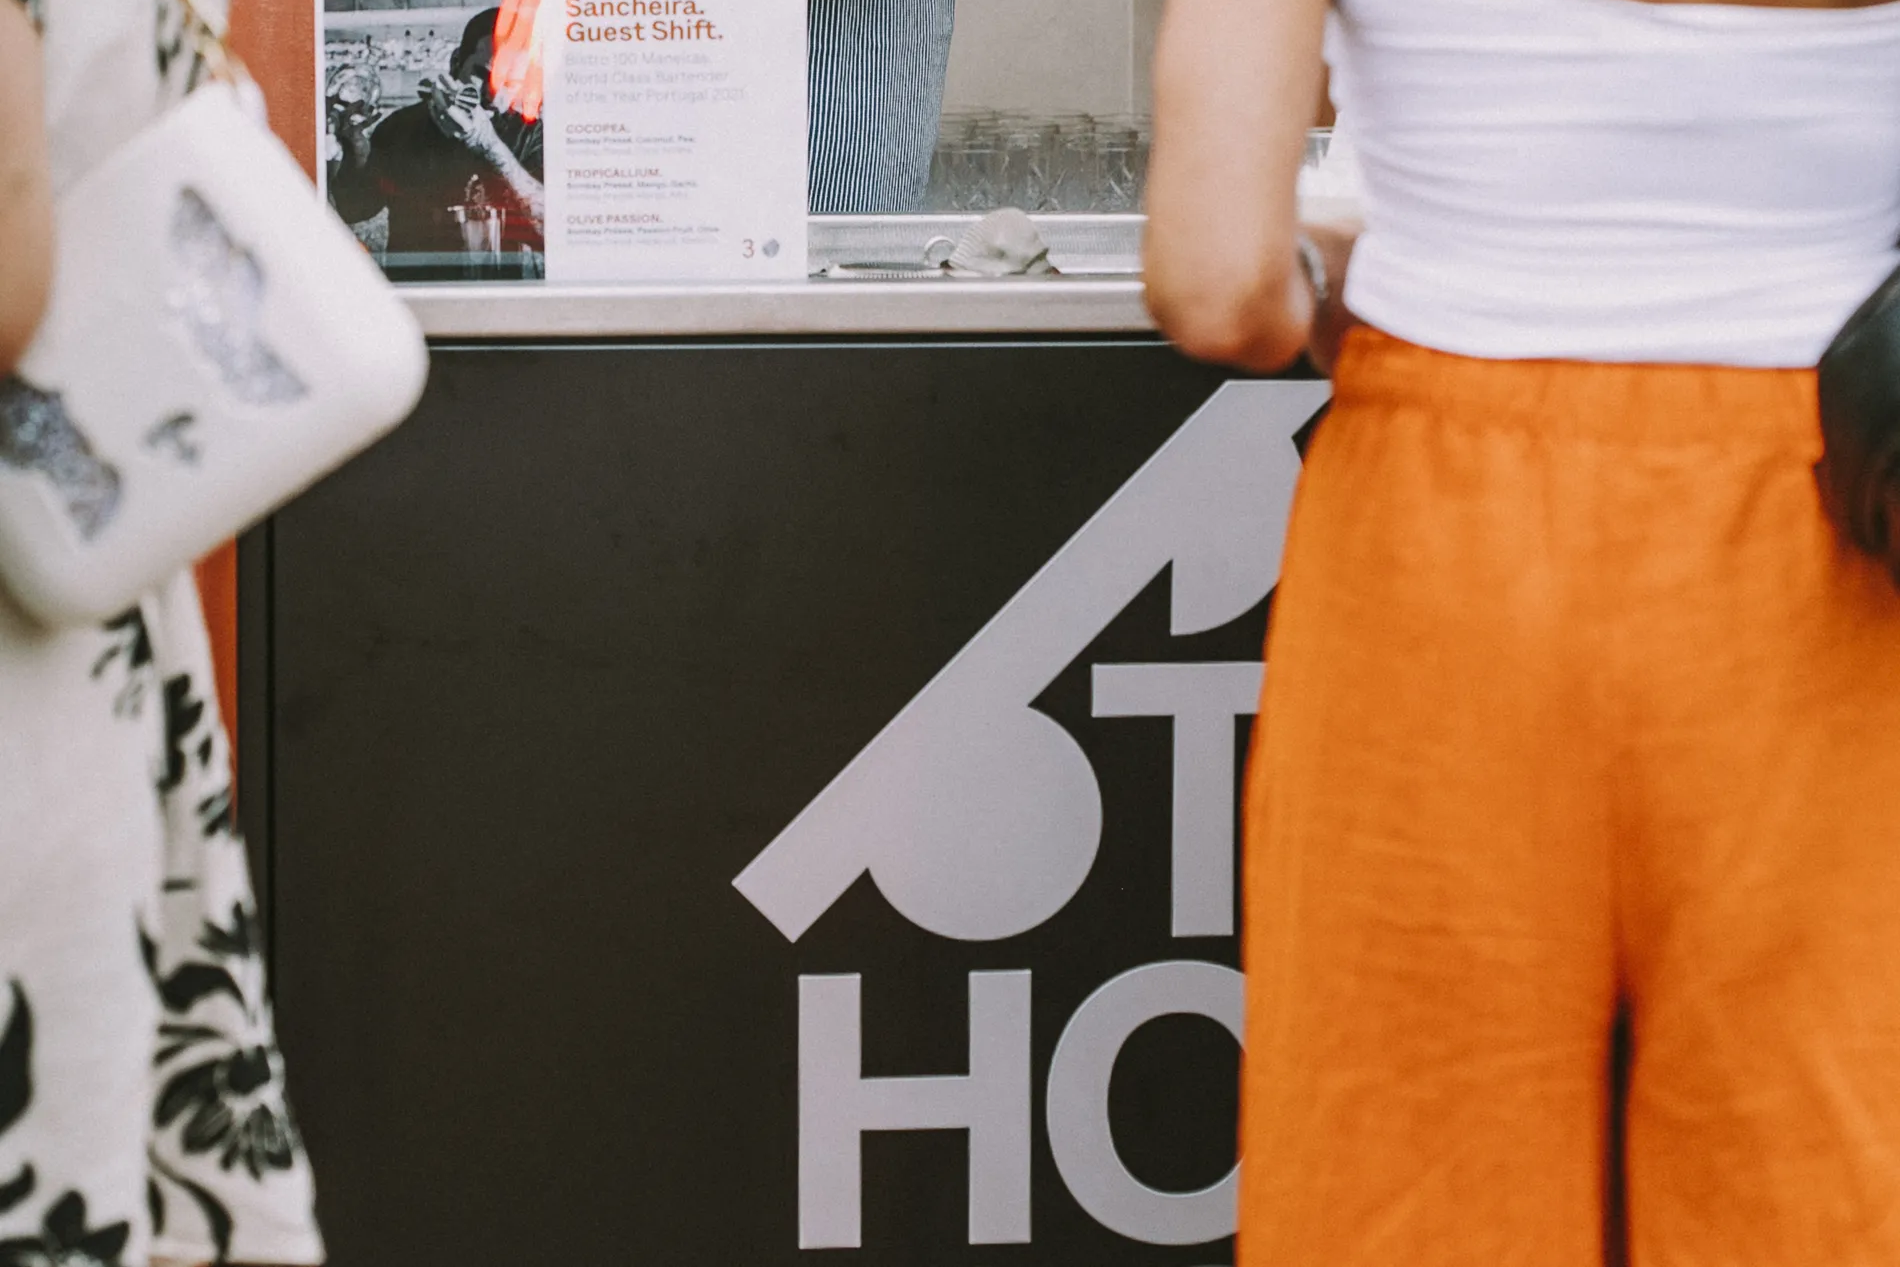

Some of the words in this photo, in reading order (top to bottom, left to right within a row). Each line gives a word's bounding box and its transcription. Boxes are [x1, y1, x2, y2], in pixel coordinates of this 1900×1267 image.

[565, 21, 645, 43] Guest
[651, 19, 723, 41] Shift.
[583, 90, 607, 103] the
[566, 214, 604, 225] OLIVE
